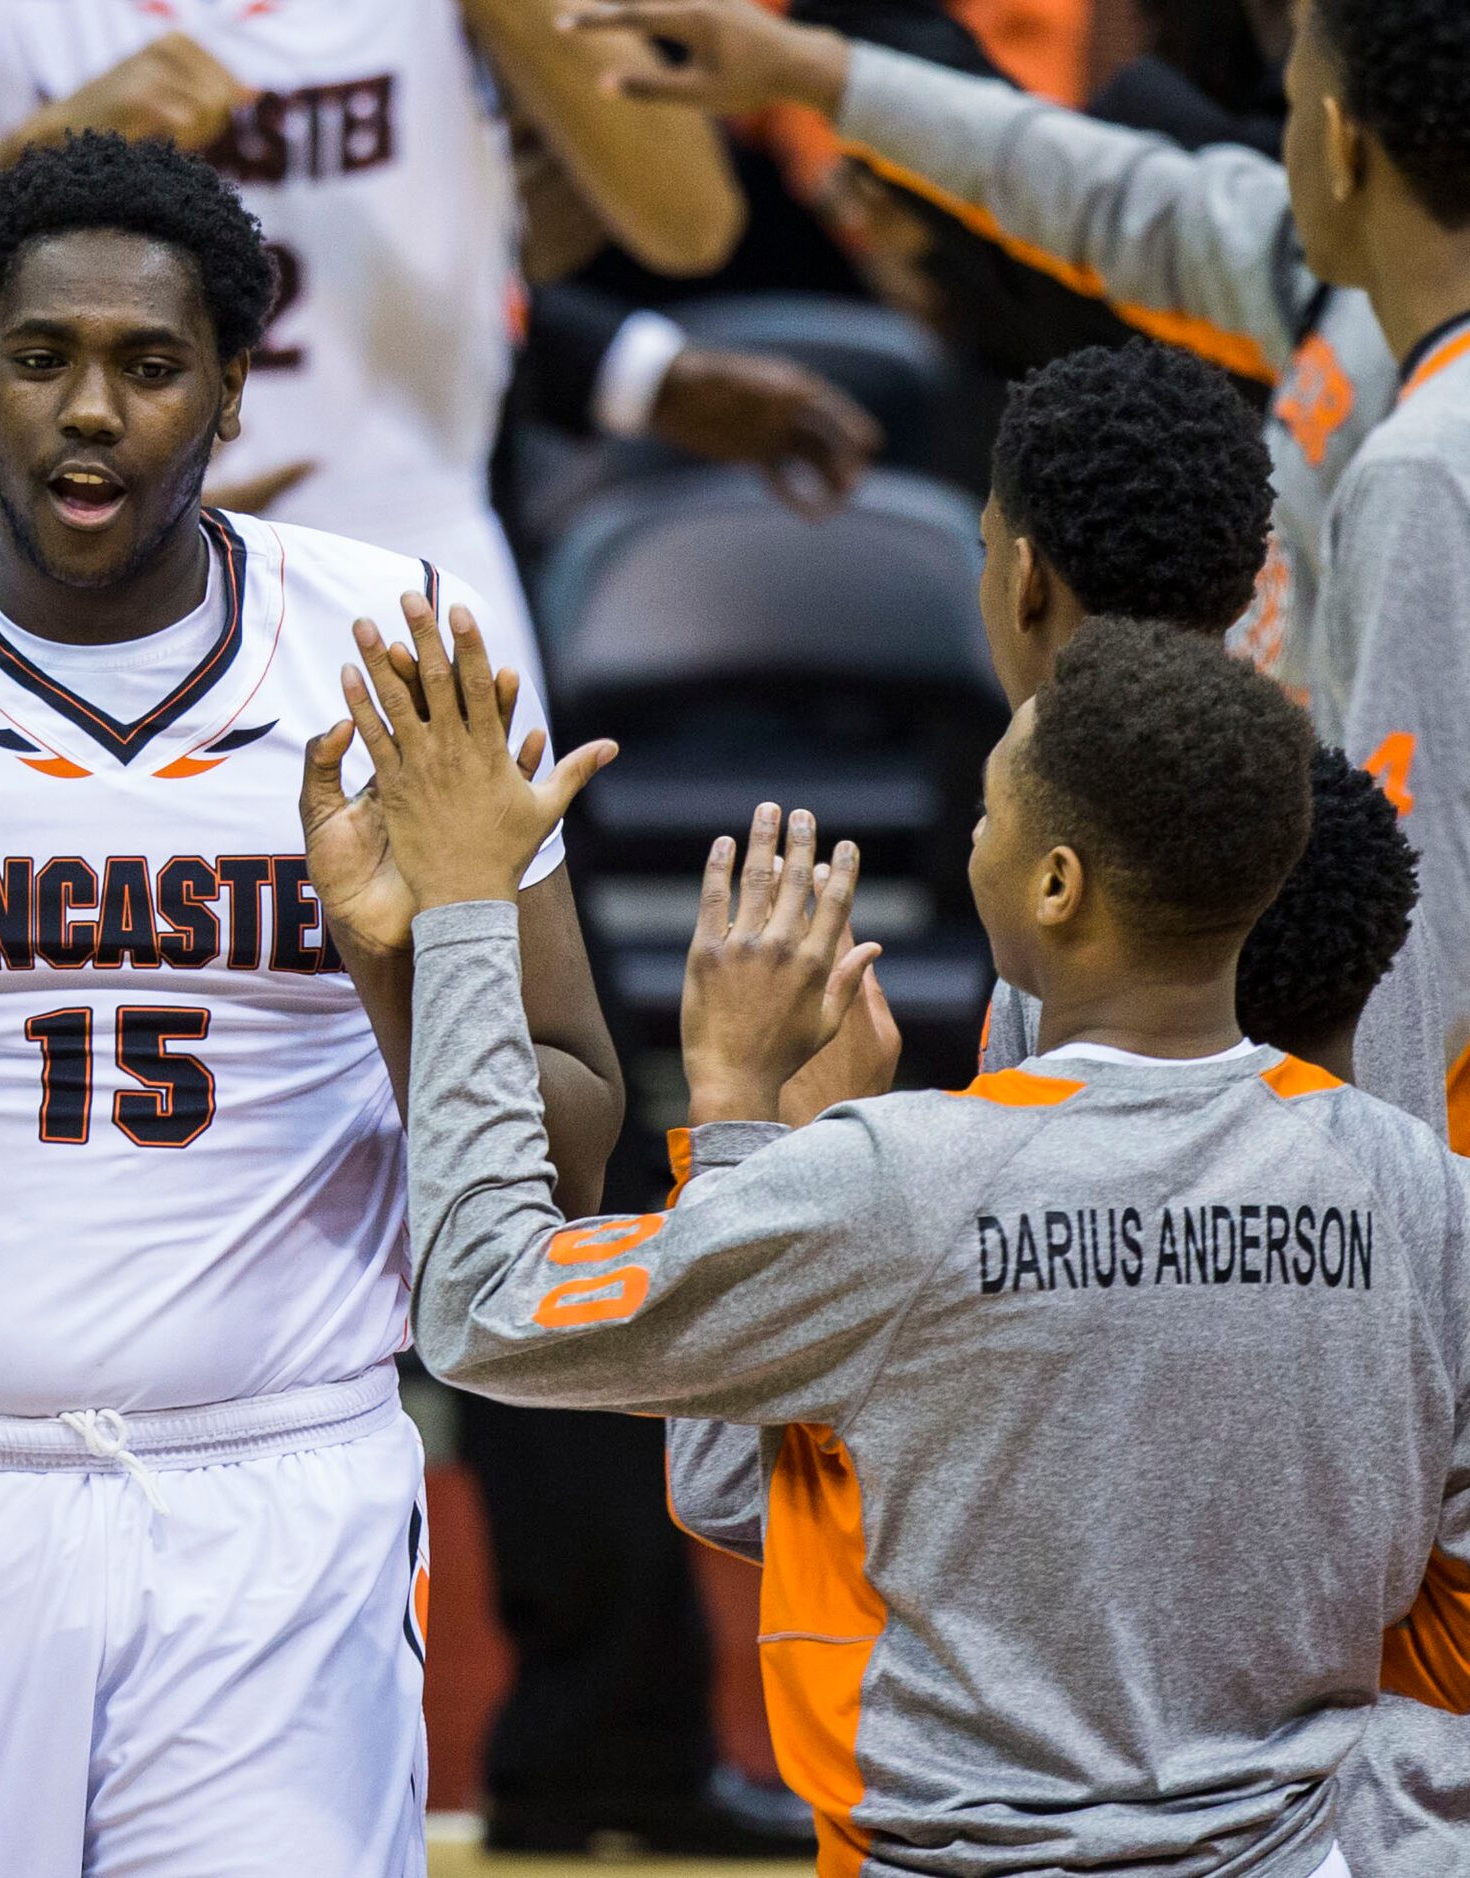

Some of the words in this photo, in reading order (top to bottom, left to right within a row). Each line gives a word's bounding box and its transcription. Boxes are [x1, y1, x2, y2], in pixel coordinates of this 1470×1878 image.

[24, 1005, 217, 1149] 15
[977, 1206, 1144, 1294] DARIUS
[1154, 1204, 1373, 1290] ANDERSON
